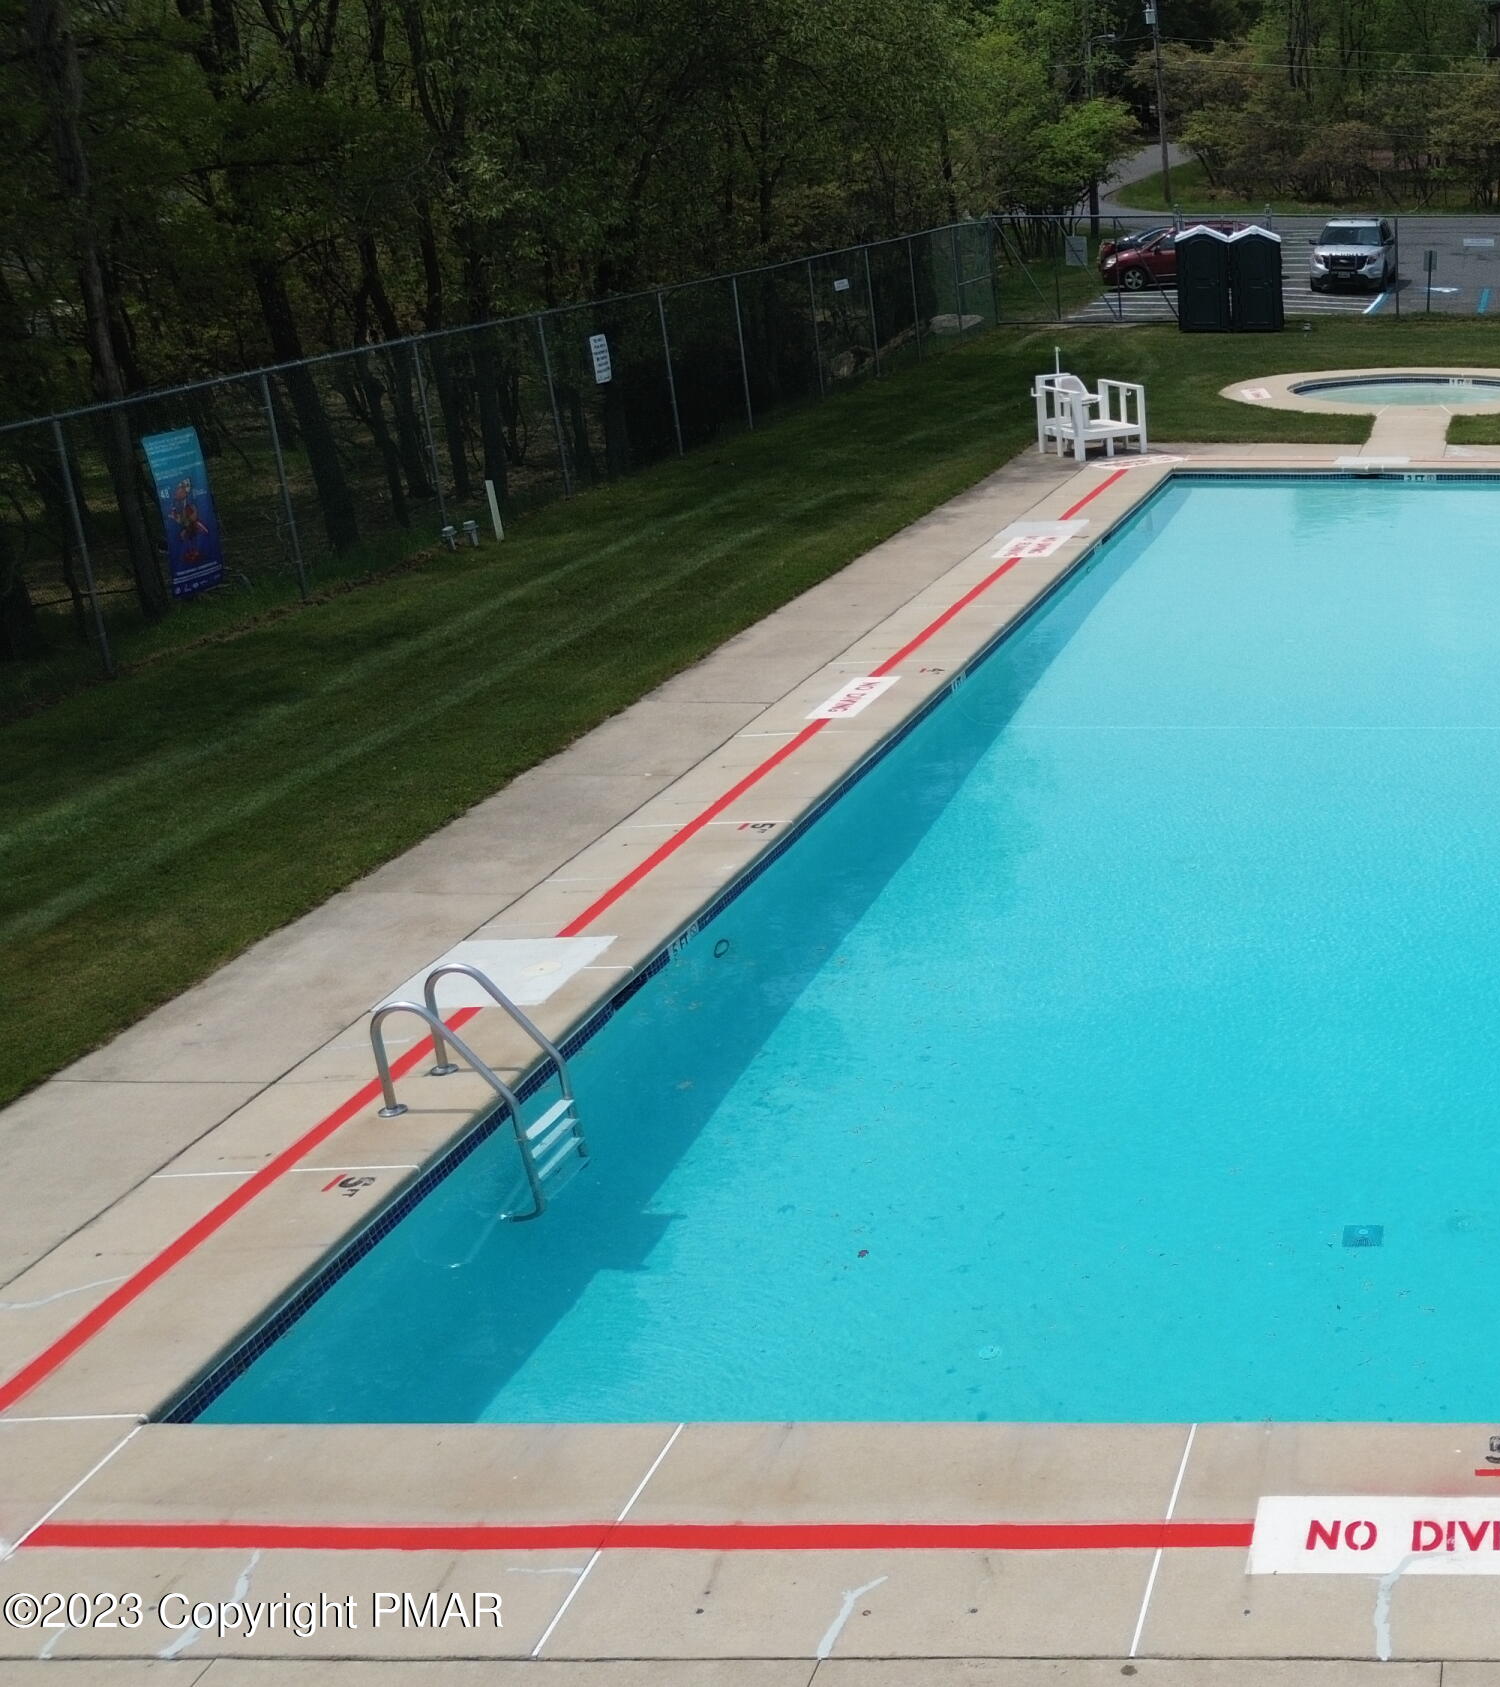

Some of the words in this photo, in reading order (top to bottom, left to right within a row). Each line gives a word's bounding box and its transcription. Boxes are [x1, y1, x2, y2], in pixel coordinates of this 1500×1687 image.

[856, 681, 881, 691] NO
[828, 692, 867, 713] DIVING
[1305, 1519, 1378, 1551] NO
